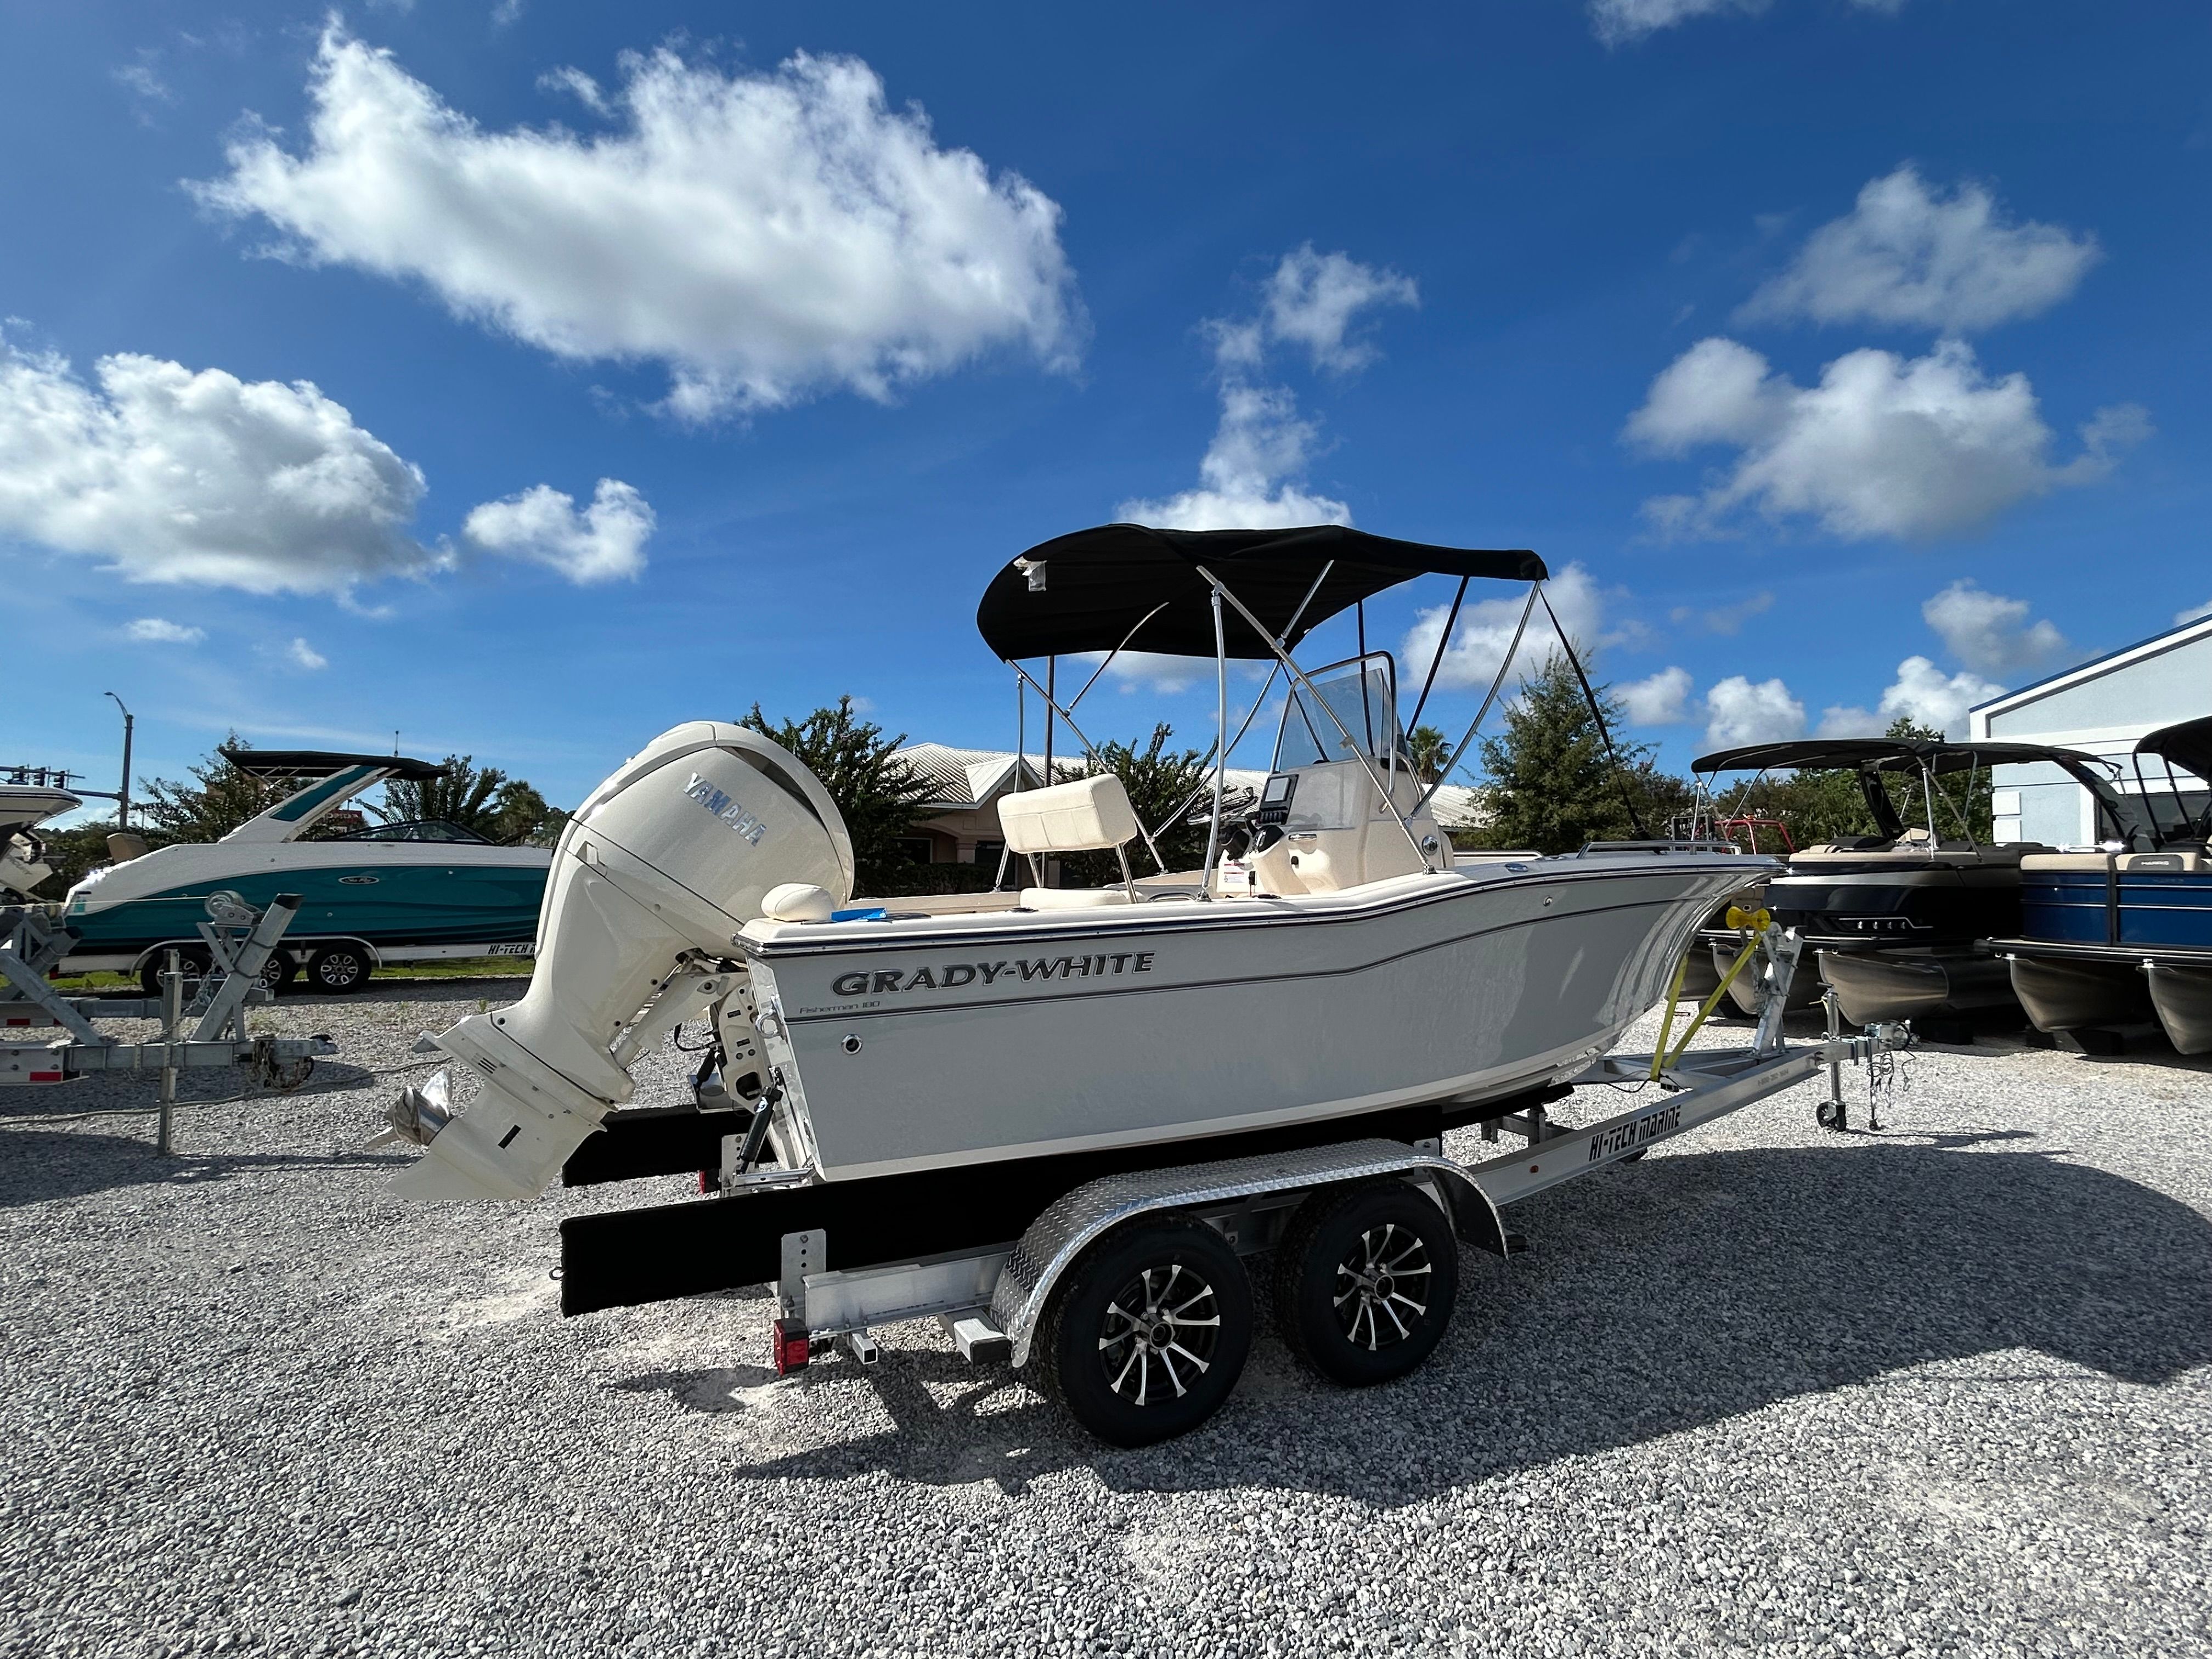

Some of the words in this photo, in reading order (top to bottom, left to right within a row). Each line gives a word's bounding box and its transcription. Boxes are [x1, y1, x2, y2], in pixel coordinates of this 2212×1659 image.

[683, 772, 766, 847] YAMAHA
[488, 944, 529, 955] HI-TECH
[831, 951, 1155, 997] GRADY-WHITE
[800, 1004, 858, 1014] Fisherman
[1589, 1121, 1637, 1161] HI-TECH
[1638, 1104, 1681, 1142] MARINE
